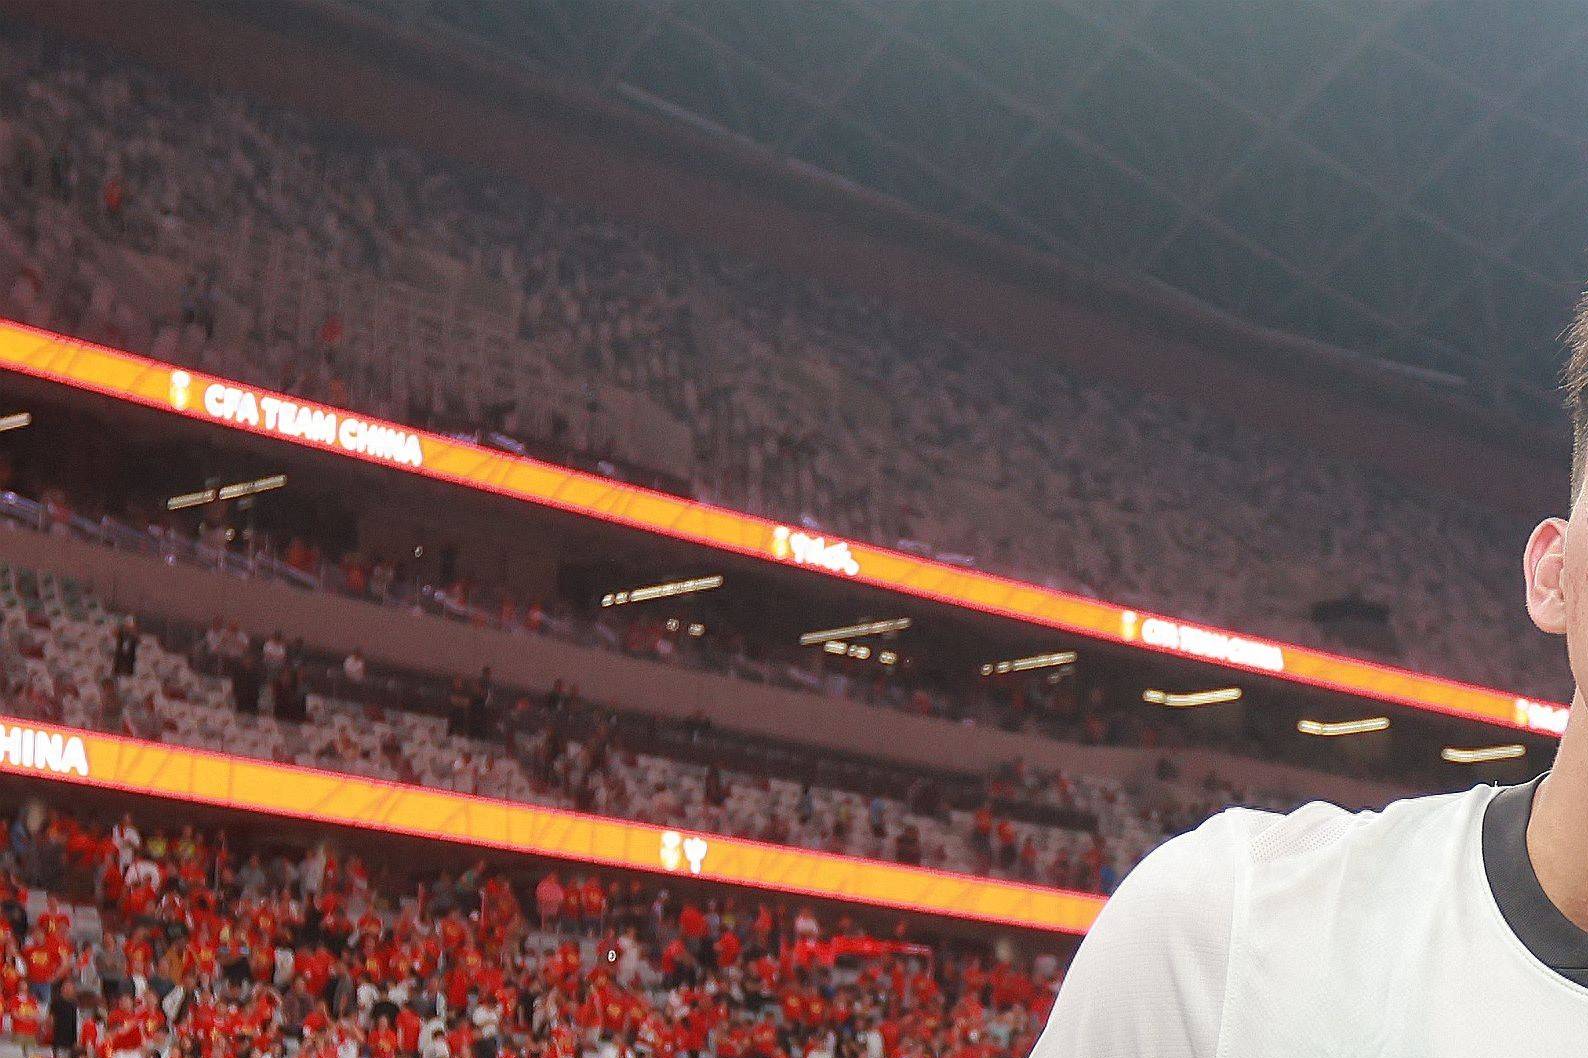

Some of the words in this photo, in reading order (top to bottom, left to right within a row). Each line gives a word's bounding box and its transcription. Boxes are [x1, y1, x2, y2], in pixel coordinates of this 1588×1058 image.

[204, 384, 259, 426] CFA
[261, 396, 337, 445] TEAM
[338, 418, 423, 467] CHINA
